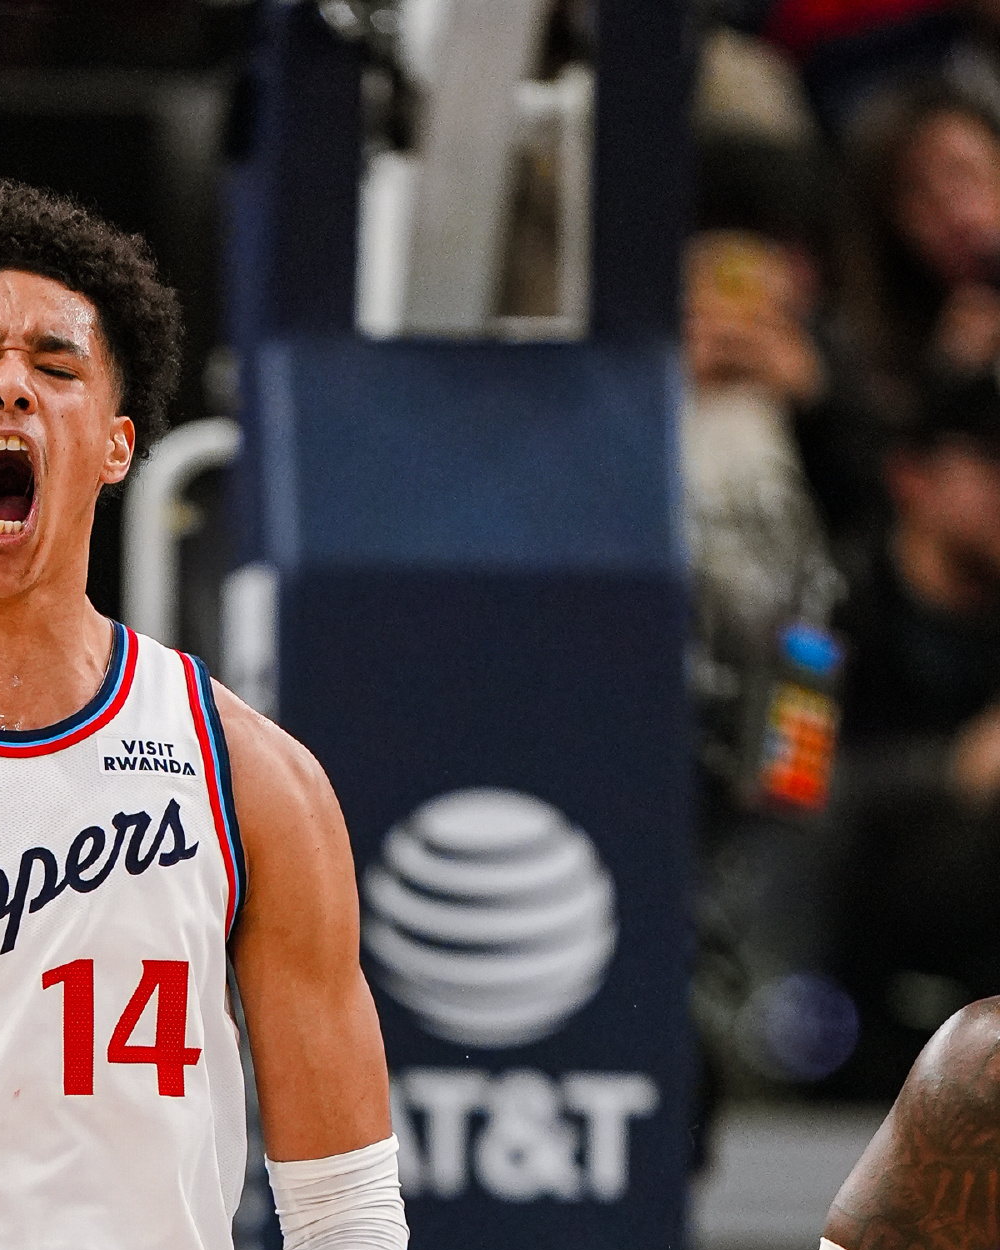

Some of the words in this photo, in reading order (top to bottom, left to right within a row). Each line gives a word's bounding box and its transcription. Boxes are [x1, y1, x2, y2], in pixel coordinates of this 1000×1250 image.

[121, 739, 174, 757] VISIT
[103, 756, 197, 776] RWANDA
[42, 959, 202, 1097] 14
